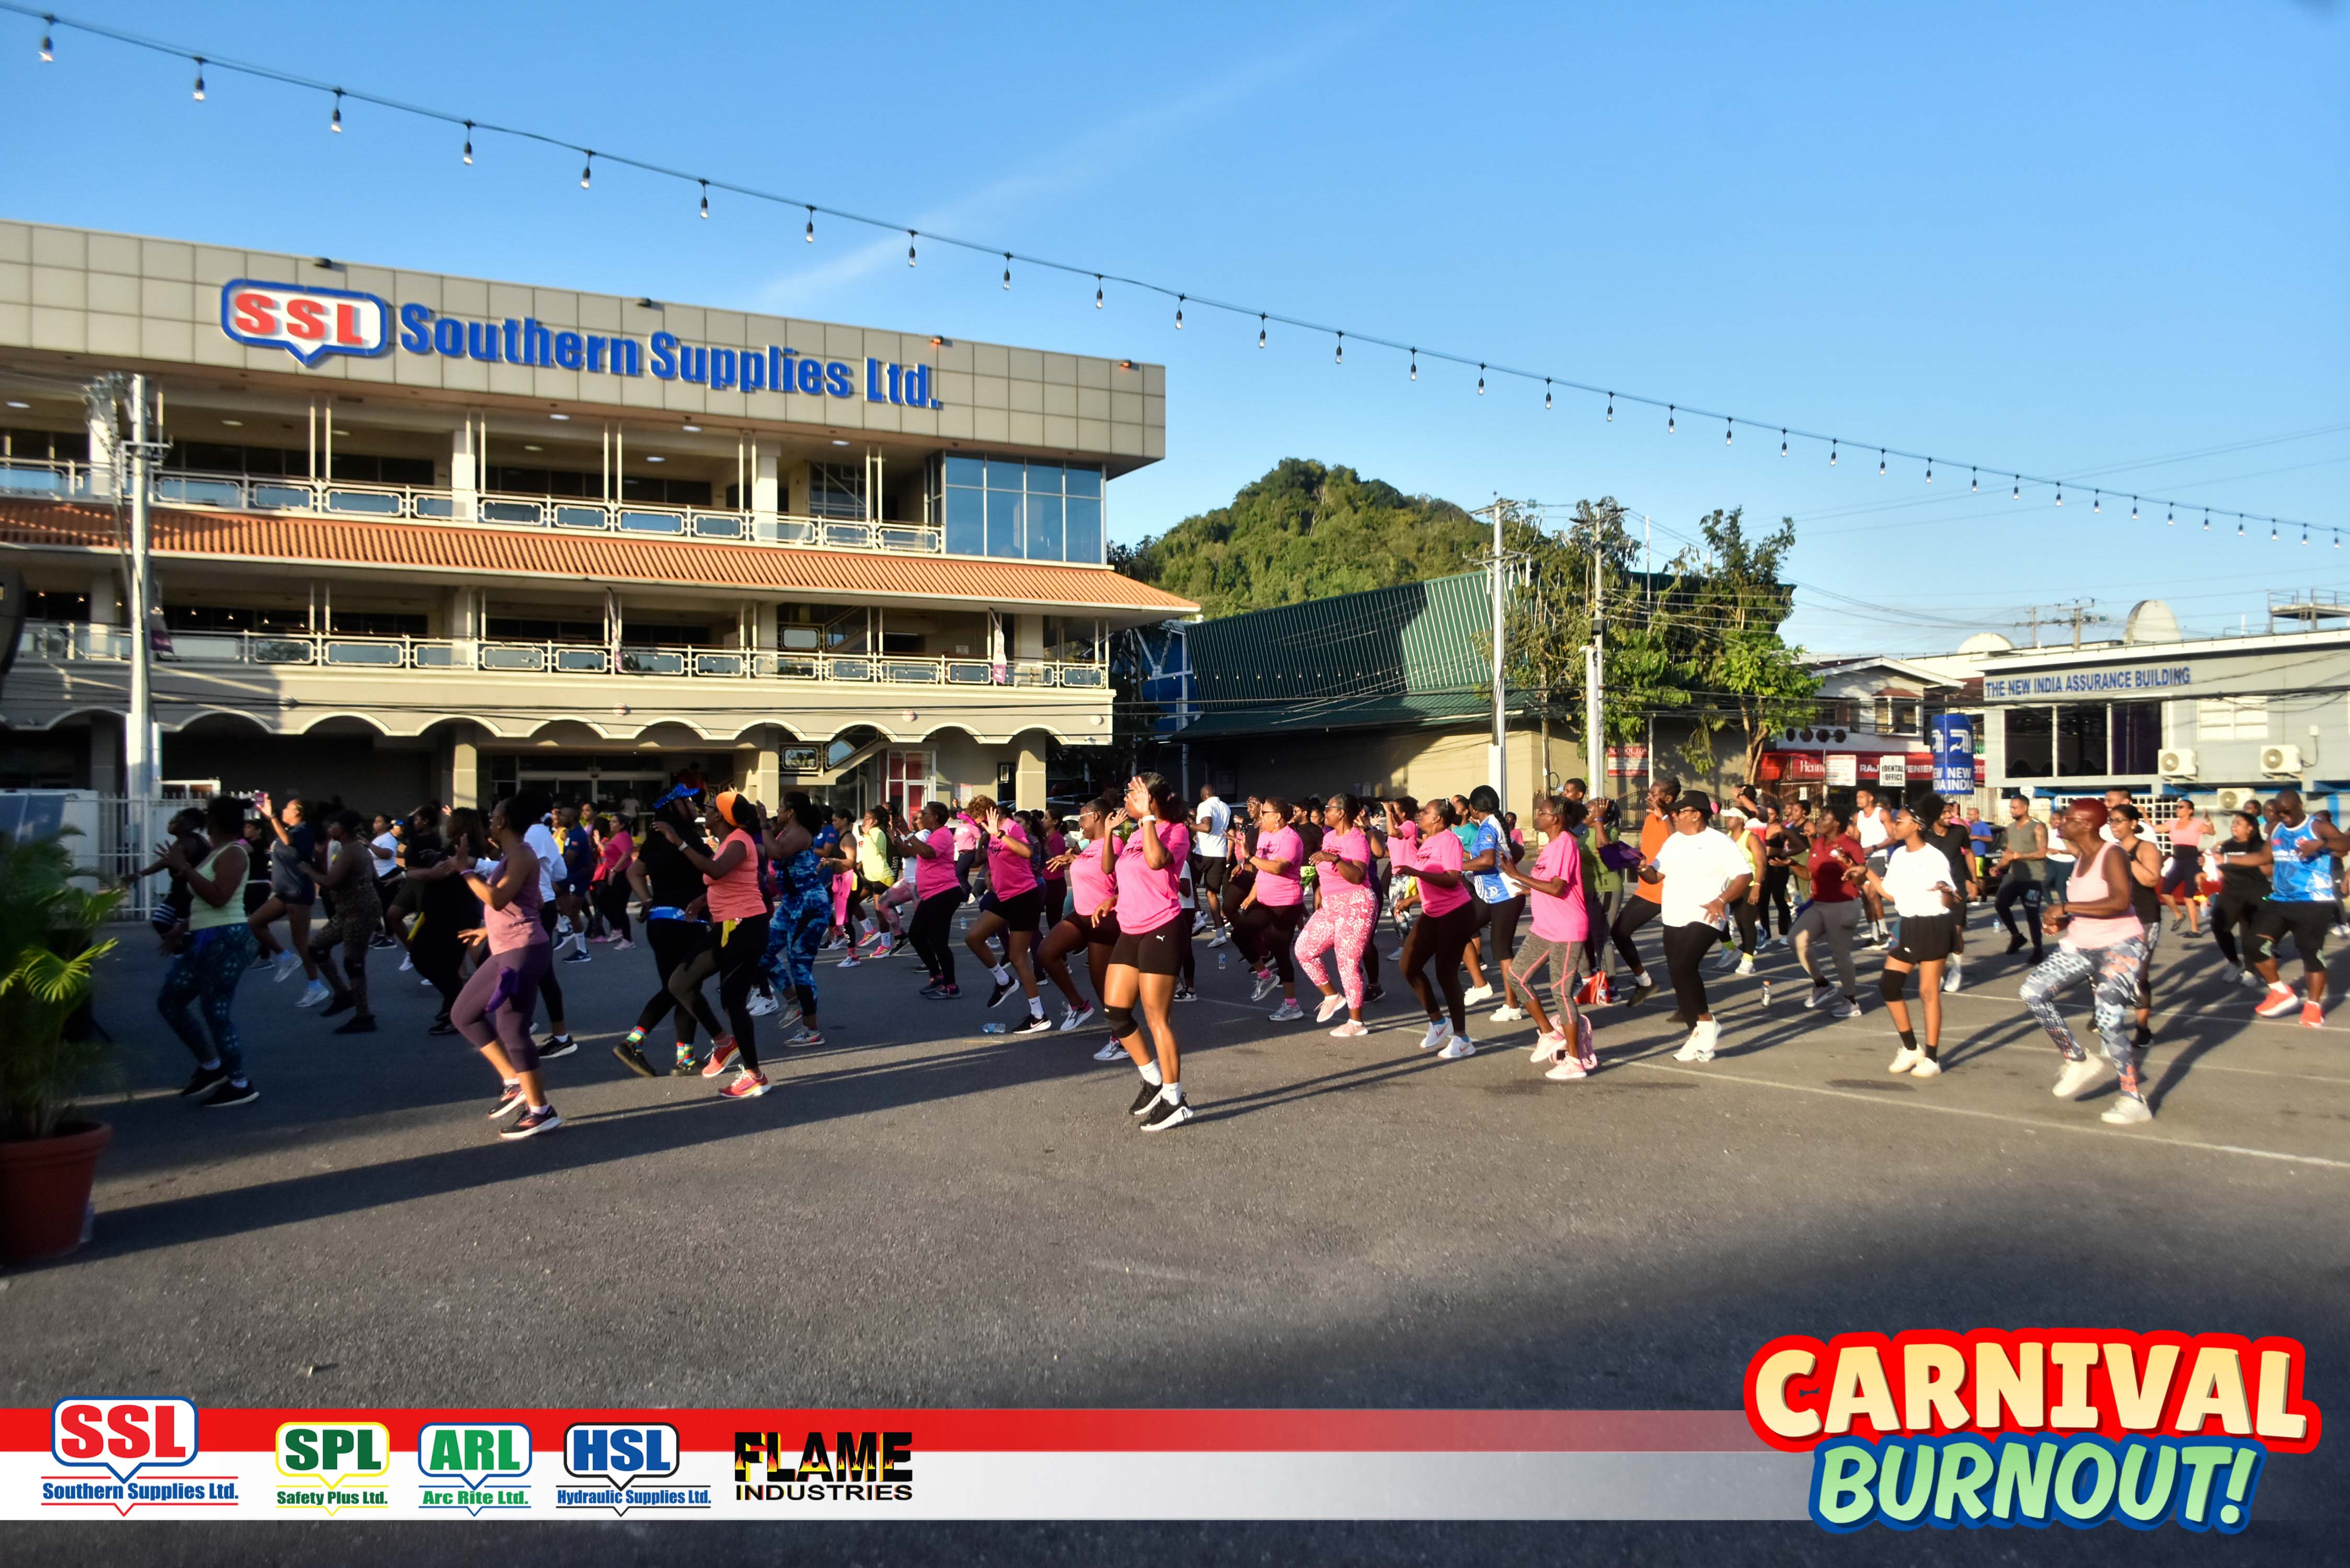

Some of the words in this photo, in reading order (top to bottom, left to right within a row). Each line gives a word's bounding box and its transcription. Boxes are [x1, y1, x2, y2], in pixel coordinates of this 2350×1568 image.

[235, 293, 363, 345] SSL
[400, 302, 638, 377] Southern
[650, 331, 850, 398] Supplies
[865, 356, 939, 408] Ltd.
[1986, 680, 2006, 698] THE
[2008, 678, 2031, 696] NEW
[2034, 676, 2062, 694] INDIA
[2065, 671, 2132, 691] ASSURANCE
[2135, 666, 2191, 687] BUILDING
[1948, 767, 1971, 778] NEW
[1948, 779, 1974, 790] INDIA
